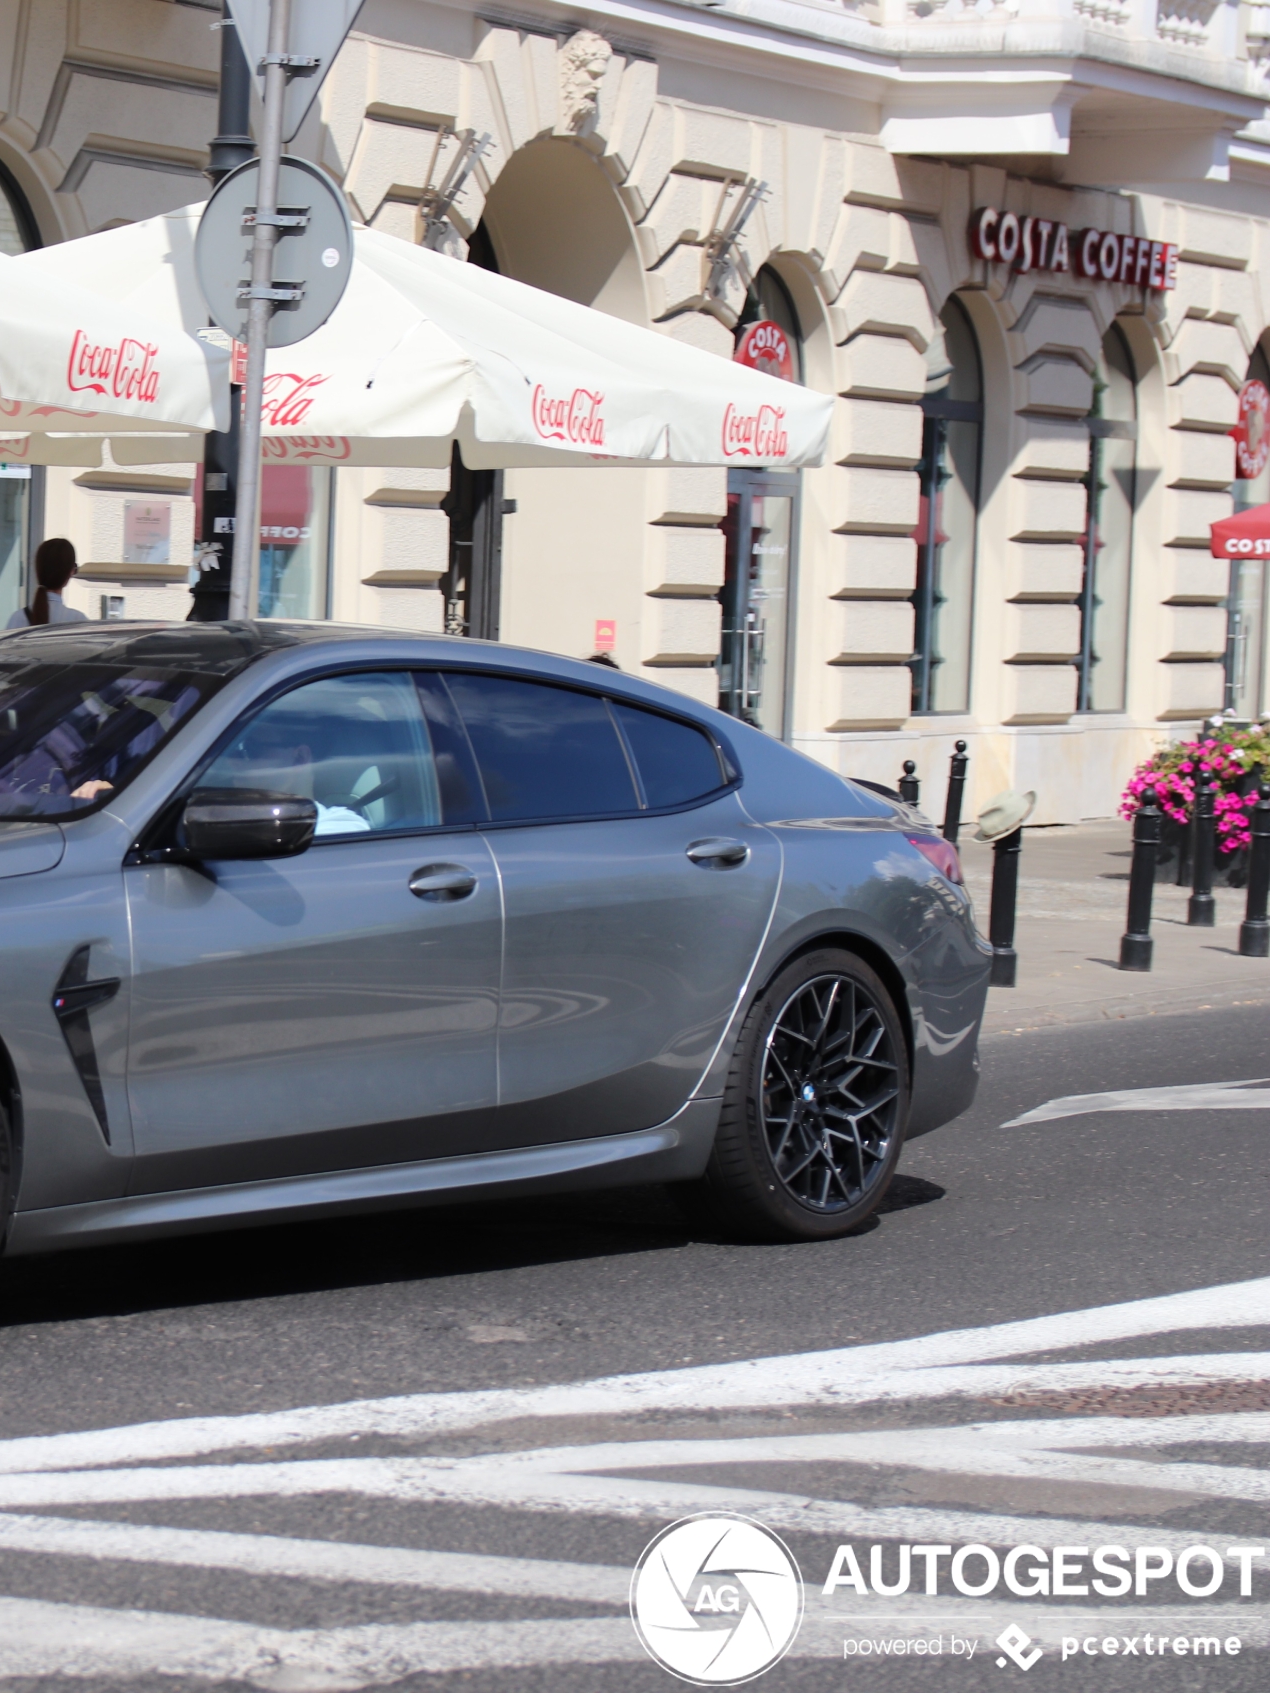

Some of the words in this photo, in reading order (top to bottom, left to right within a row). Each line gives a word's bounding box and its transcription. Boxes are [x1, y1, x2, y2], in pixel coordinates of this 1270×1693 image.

[977, 207, 1069, 274] COSTA
[1082, 228, 1179, 291] COFFEE
[67, 329, 161, 403] Coca-Cola
[748, 326, 787, 362] COSTA
[532, 384, 607, 446] Coca-Cola
[721, 402, 790, 457] Coca-Cola
